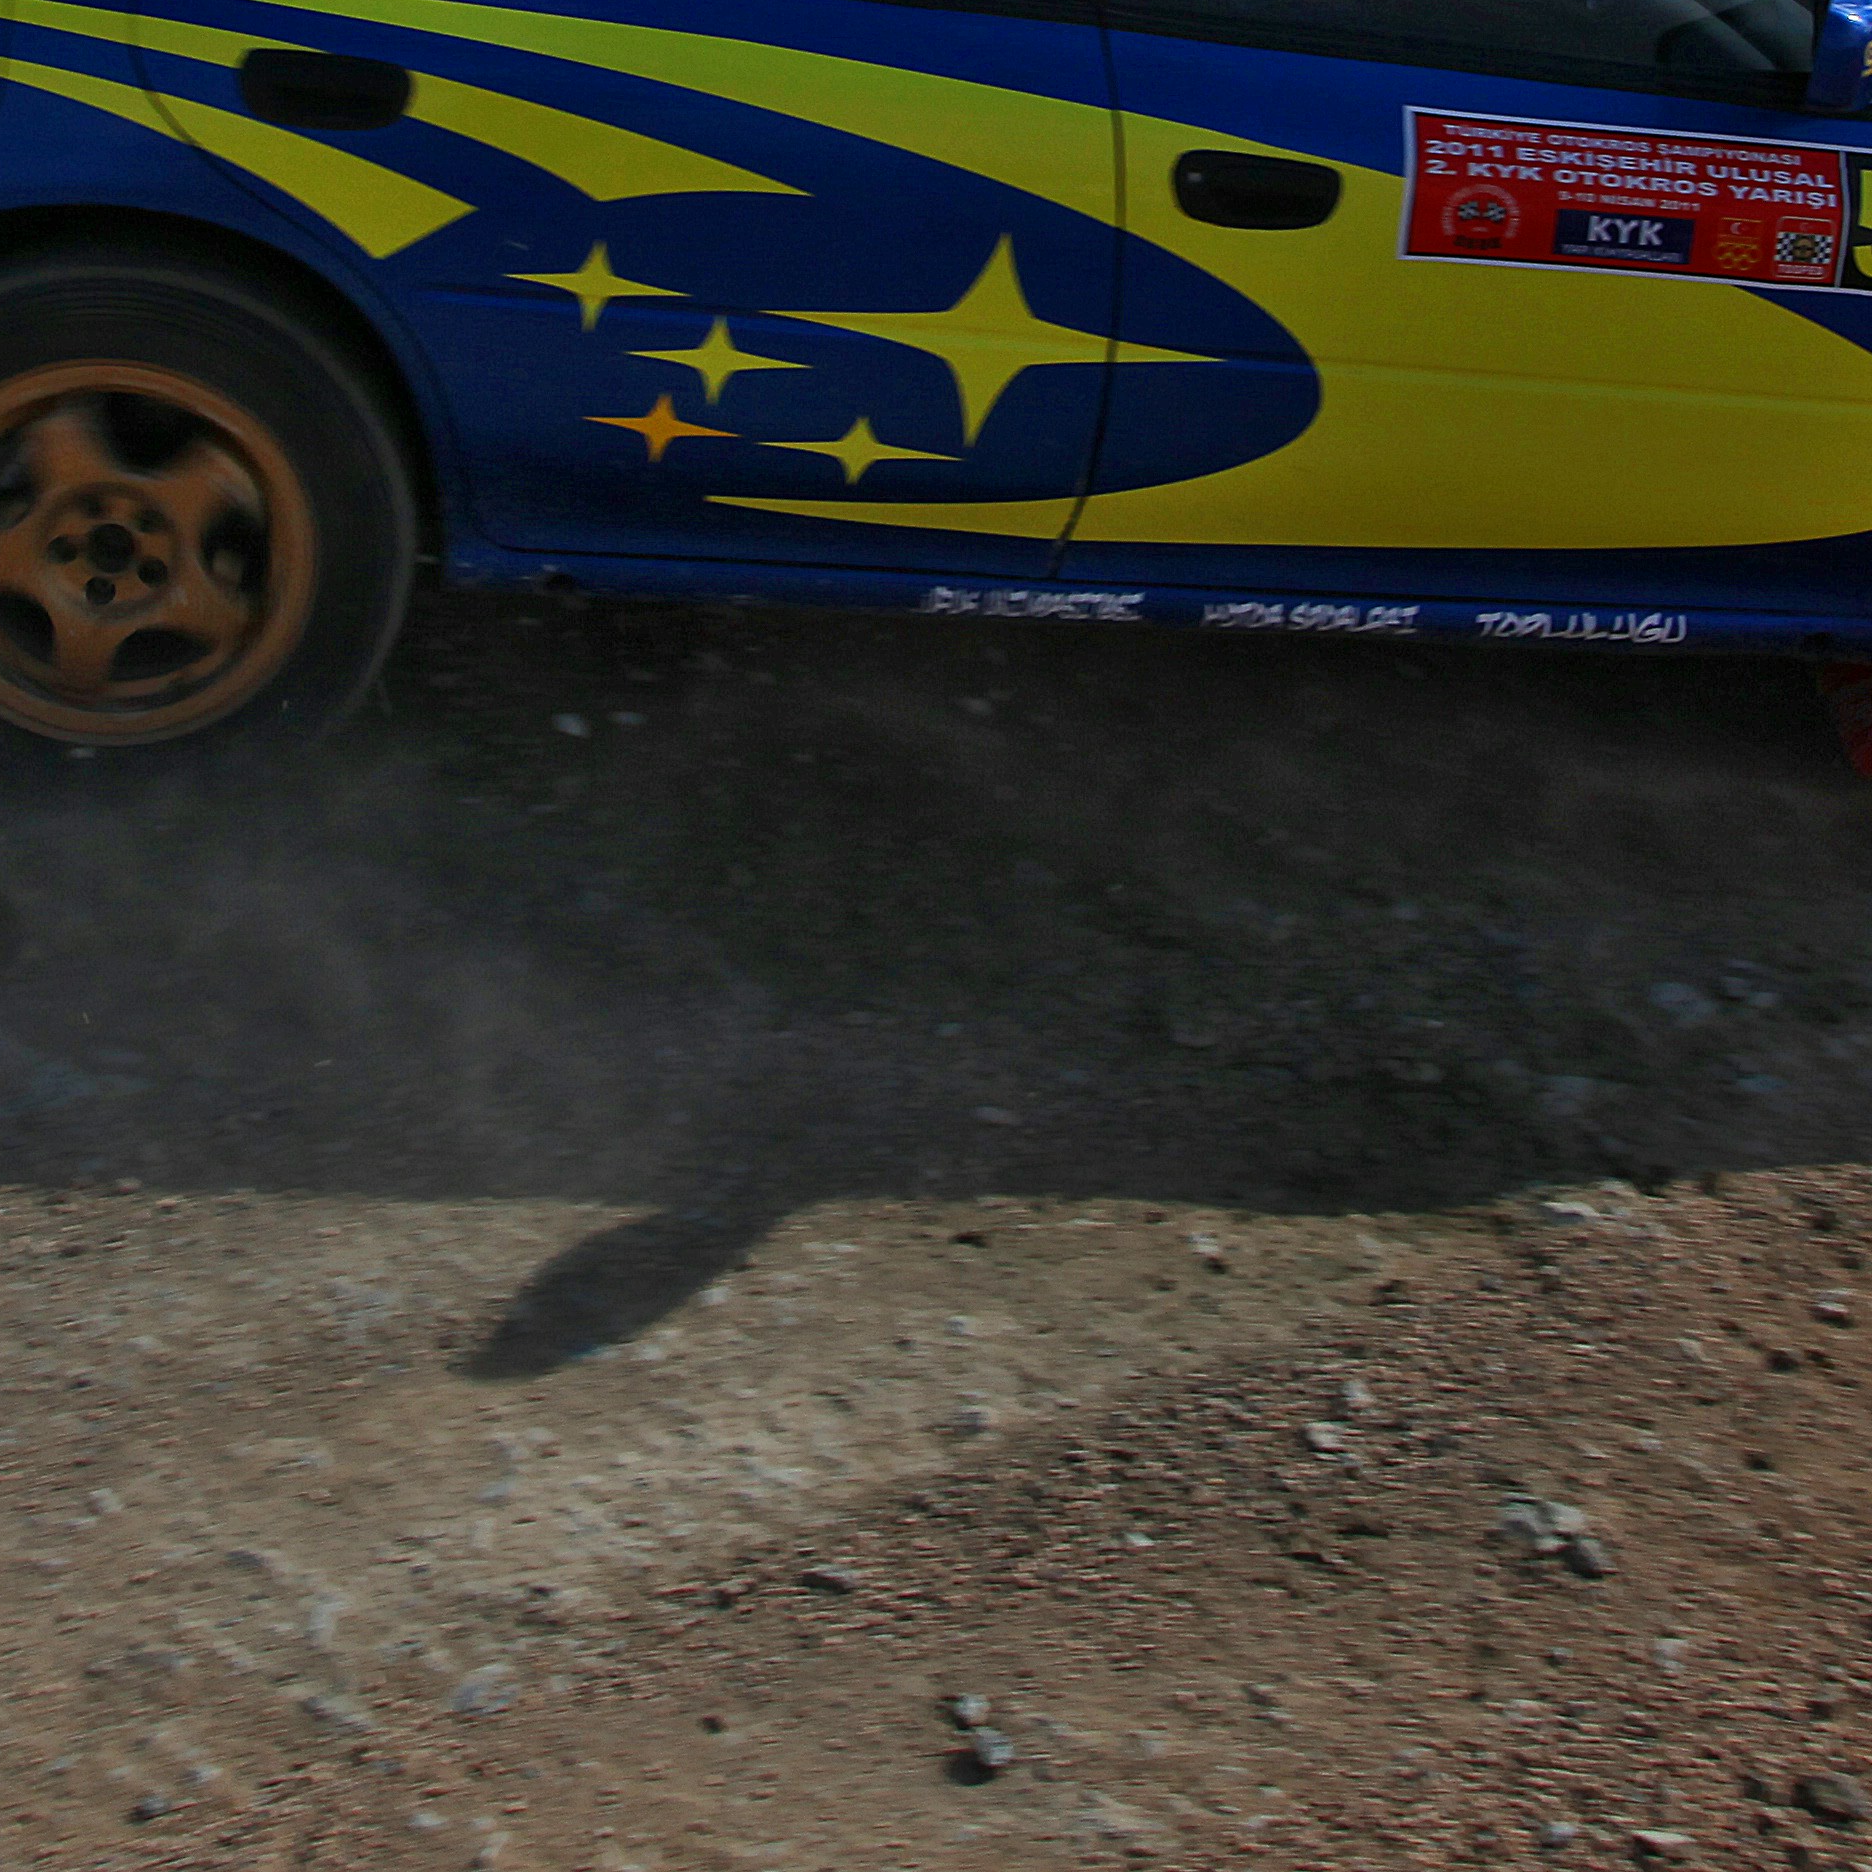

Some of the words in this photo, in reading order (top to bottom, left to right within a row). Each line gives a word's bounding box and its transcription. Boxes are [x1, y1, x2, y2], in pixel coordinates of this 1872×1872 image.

[1425, 140, 1504, 158] 2011
[1516, 146, 1697, 175] ESKİŞEHİR
[1705, 164, 1835, 188] ULUSAL
[1425, 159, 1458, 175] 2.
[1466, 162, 1543, 181] KYK
[1552, 169, 1719, 196] OTOKROS
[1727, 185, 1838, 210] YARIŞI
[1587, 215, 1664, 246] KYK
